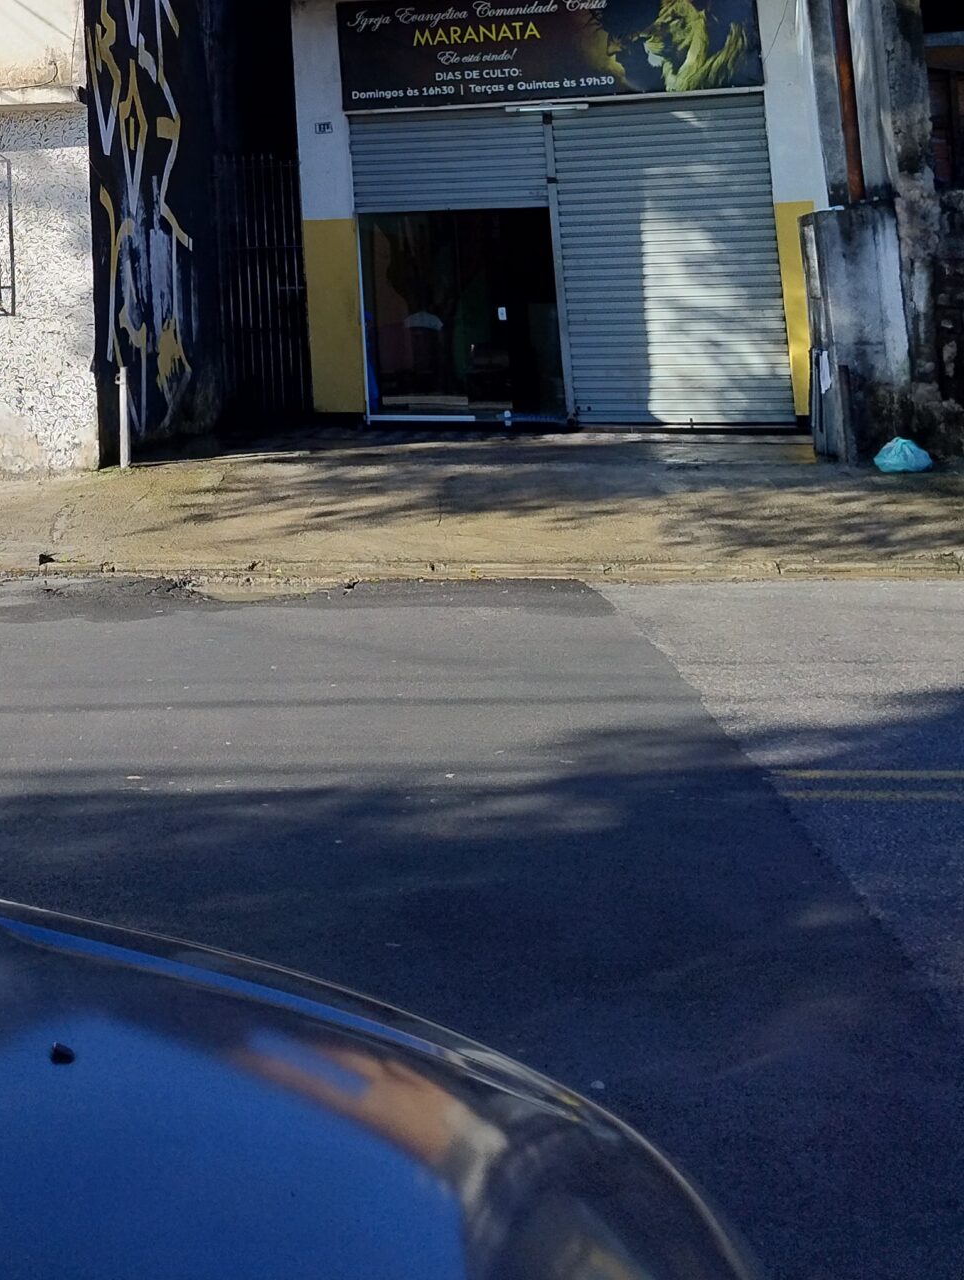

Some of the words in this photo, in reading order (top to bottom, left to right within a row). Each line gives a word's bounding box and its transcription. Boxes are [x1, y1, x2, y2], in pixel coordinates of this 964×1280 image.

[347, 10, 392, 32] Igreja
[472, 0, 558, 18] Comunidade
[413, 21, 541, 47] MARANATA
[437, 51, 460, 65] Ele
[461, 52, 481, 63] está
[435, 71, 462, 81] DIAS
[464, 70, 481, 80] DE
[482, 67, 523, 78] CULTO:
[351, 89, 404, 100] Domingos
[406, 87, 419, 96] às
[422, 85, 455, 96] 16h30
[469, 83, 505, 94] Terças
[507, 83, 515, 91] e
[517, 80, 560, 90] Quintas
[562, 78, 577, 88] às
[579, 76, 615, 87] 19h30
